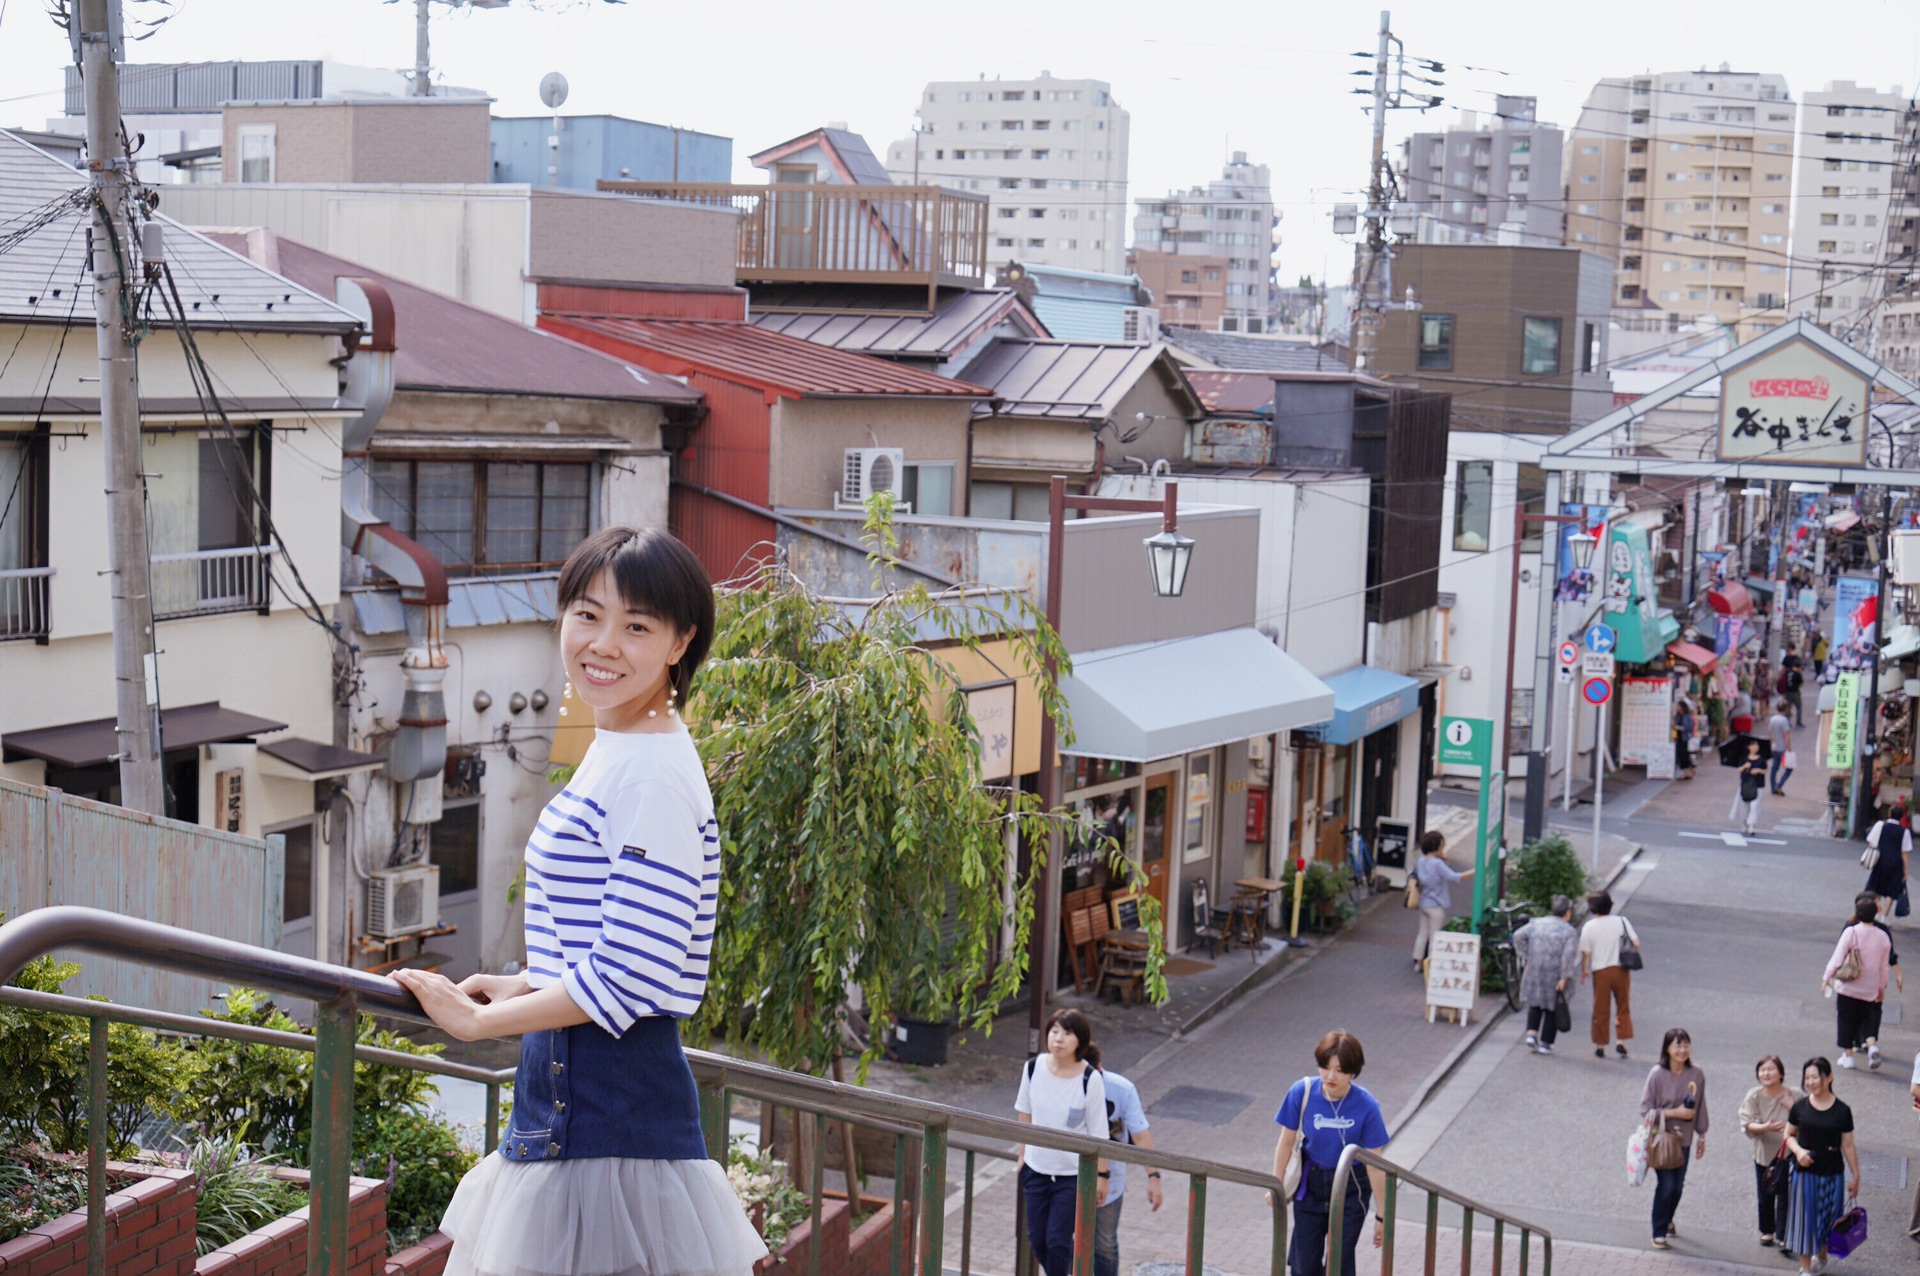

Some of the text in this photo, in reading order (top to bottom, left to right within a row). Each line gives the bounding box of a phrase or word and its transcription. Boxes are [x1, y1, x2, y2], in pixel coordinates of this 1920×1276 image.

[1751, 375, 1829, 400] ひぐらしの里
[1732, 396, 1857, 450] 谷中ぎんざ
